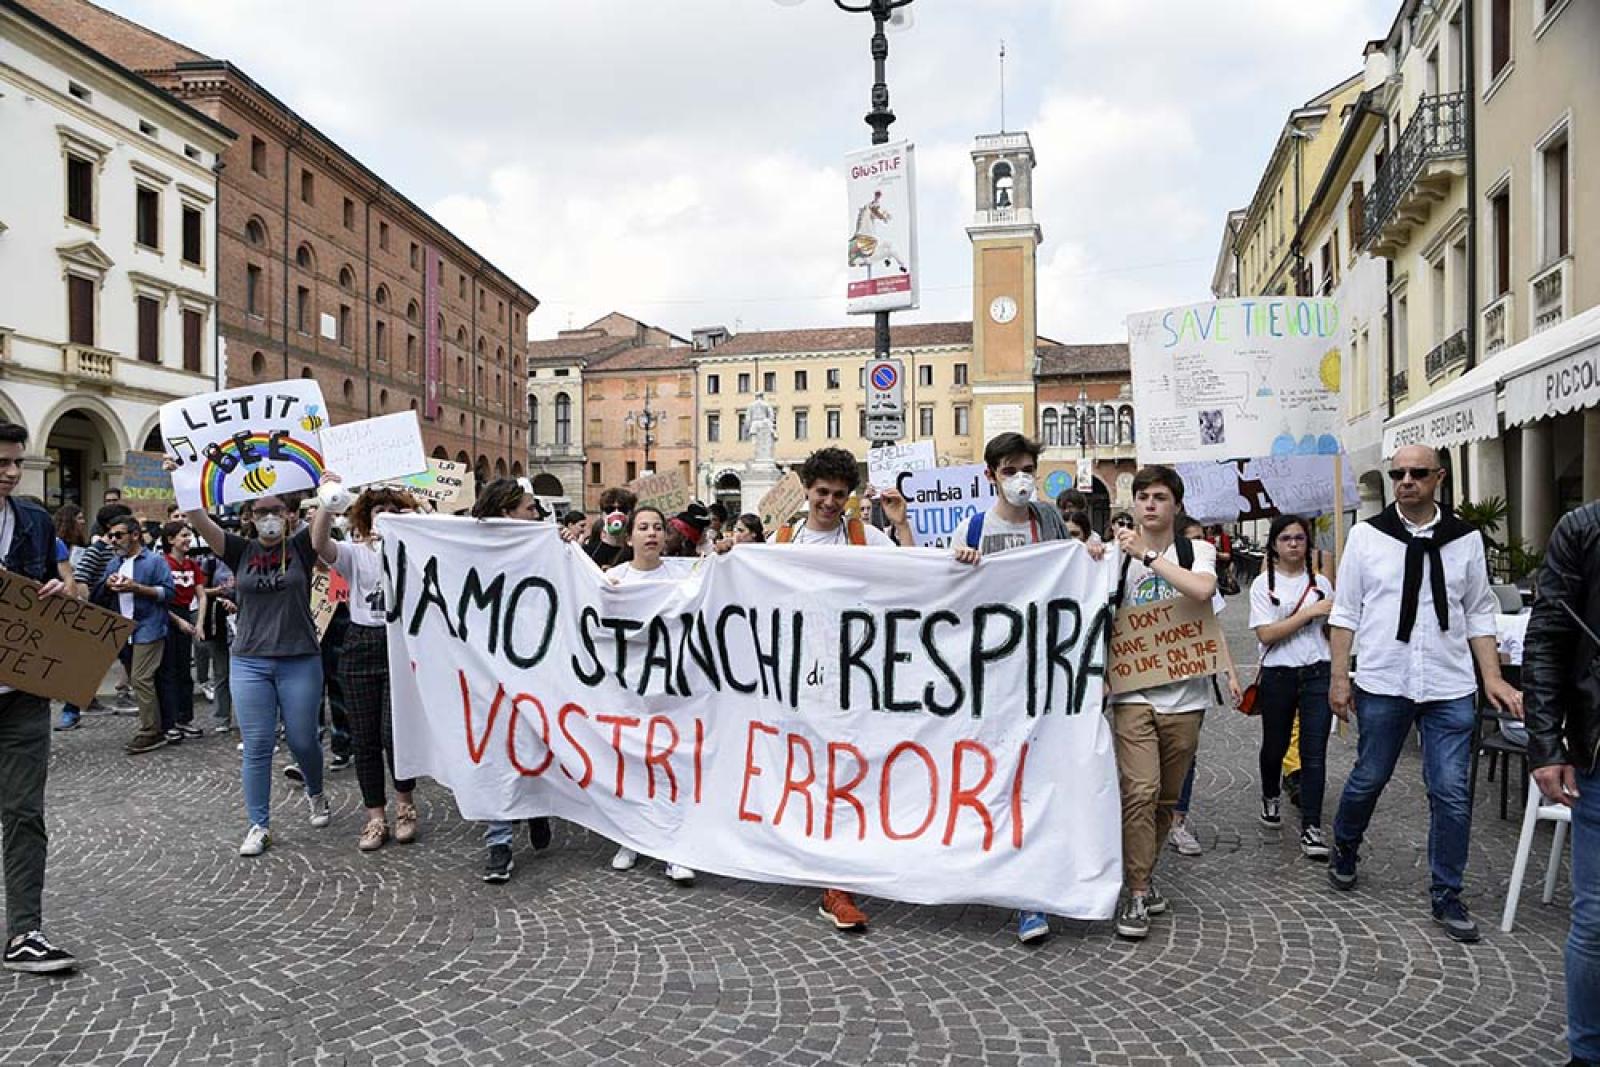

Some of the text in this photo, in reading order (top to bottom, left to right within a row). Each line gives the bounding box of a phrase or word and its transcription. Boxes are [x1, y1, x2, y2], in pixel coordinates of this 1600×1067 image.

[181, 394, 300, 431] LET IT
[202, 430, 290, 474] BEE
[896, 471, 962, 502] Cambia
[970, 475, 980, 498] il
[0, 576, 129, 649] LSTREJK
[1128, 605, 1173, 631] DON'T
[0, 618, 43, 650] ÖR
[1111, 620, 1204, 658] HAVE MONEY
[571, 604, 803, 708] STANCHI
[806, 660, 825, 686] di
[1112, 639, 1217, 678] TO LIVE ON THE
[457, 668, 1030, 852] VOSTRI ERRORI
